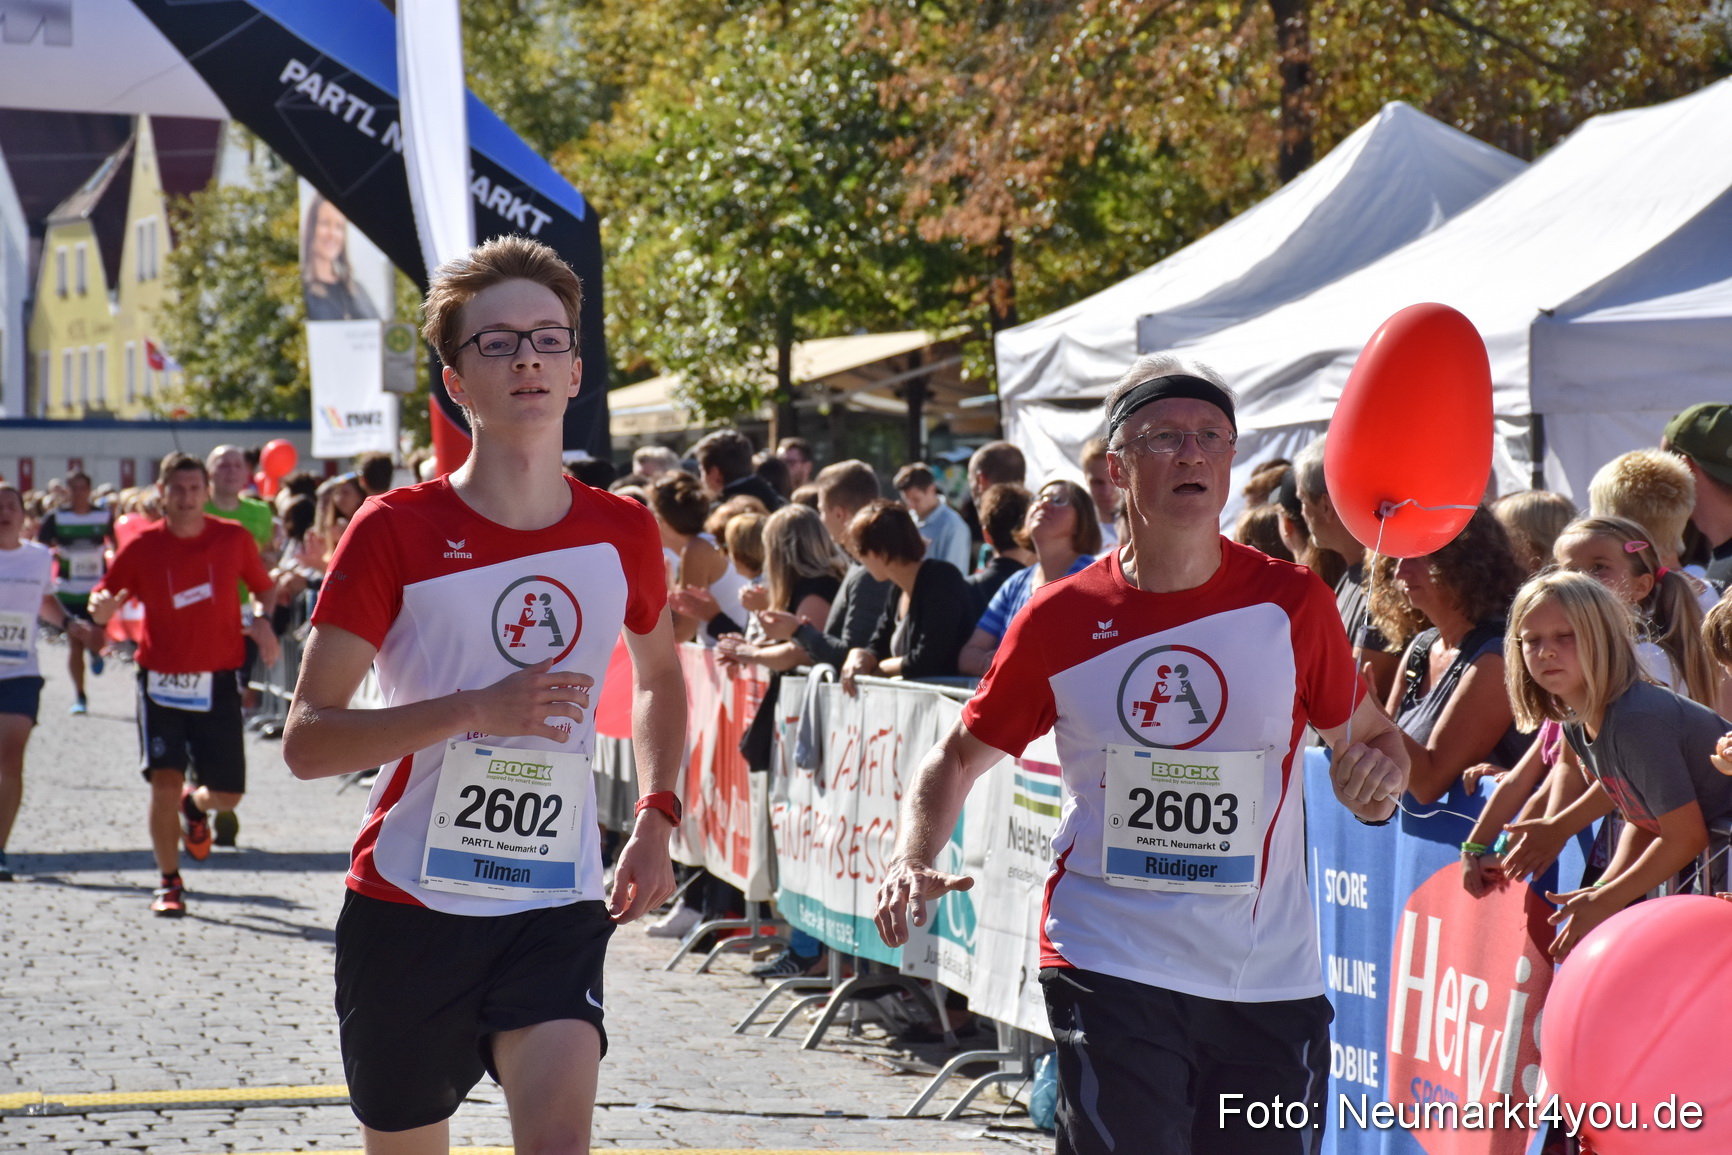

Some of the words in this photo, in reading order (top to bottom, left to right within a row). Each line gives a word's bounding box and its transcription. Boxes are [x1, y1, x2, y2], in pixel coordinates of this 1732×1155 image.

[279, 58, 377, 138] PARTL
[381, 121, 552, 236] NARKT
[443, 550, 472, 559] erima
[1092, 629, 1119, 640] erima
[488, 759, 554, 781] BOCK
[1152, 762, 1219, 781] BOCK
[438, 816, 445, 825] D
[454, 785, 563, 838] 2602
[1113, 817, 1119, 826] D
[1128, 787, 1238, 835] 2603
[461, 836, 494, 849] PARTL
[496, 842, 537, 853] Neumarkt
[1137, 836, 1168, 848] PARTL
[1170, 839, 1216, 850] Neumarkt
[473, 858, 531, 883] Tilman
[1145, 856, 1218, 880] Rüdiger
[1325, 868, 1368, 909] STORE
[1328, 954, 1376, 999] ONLINE
